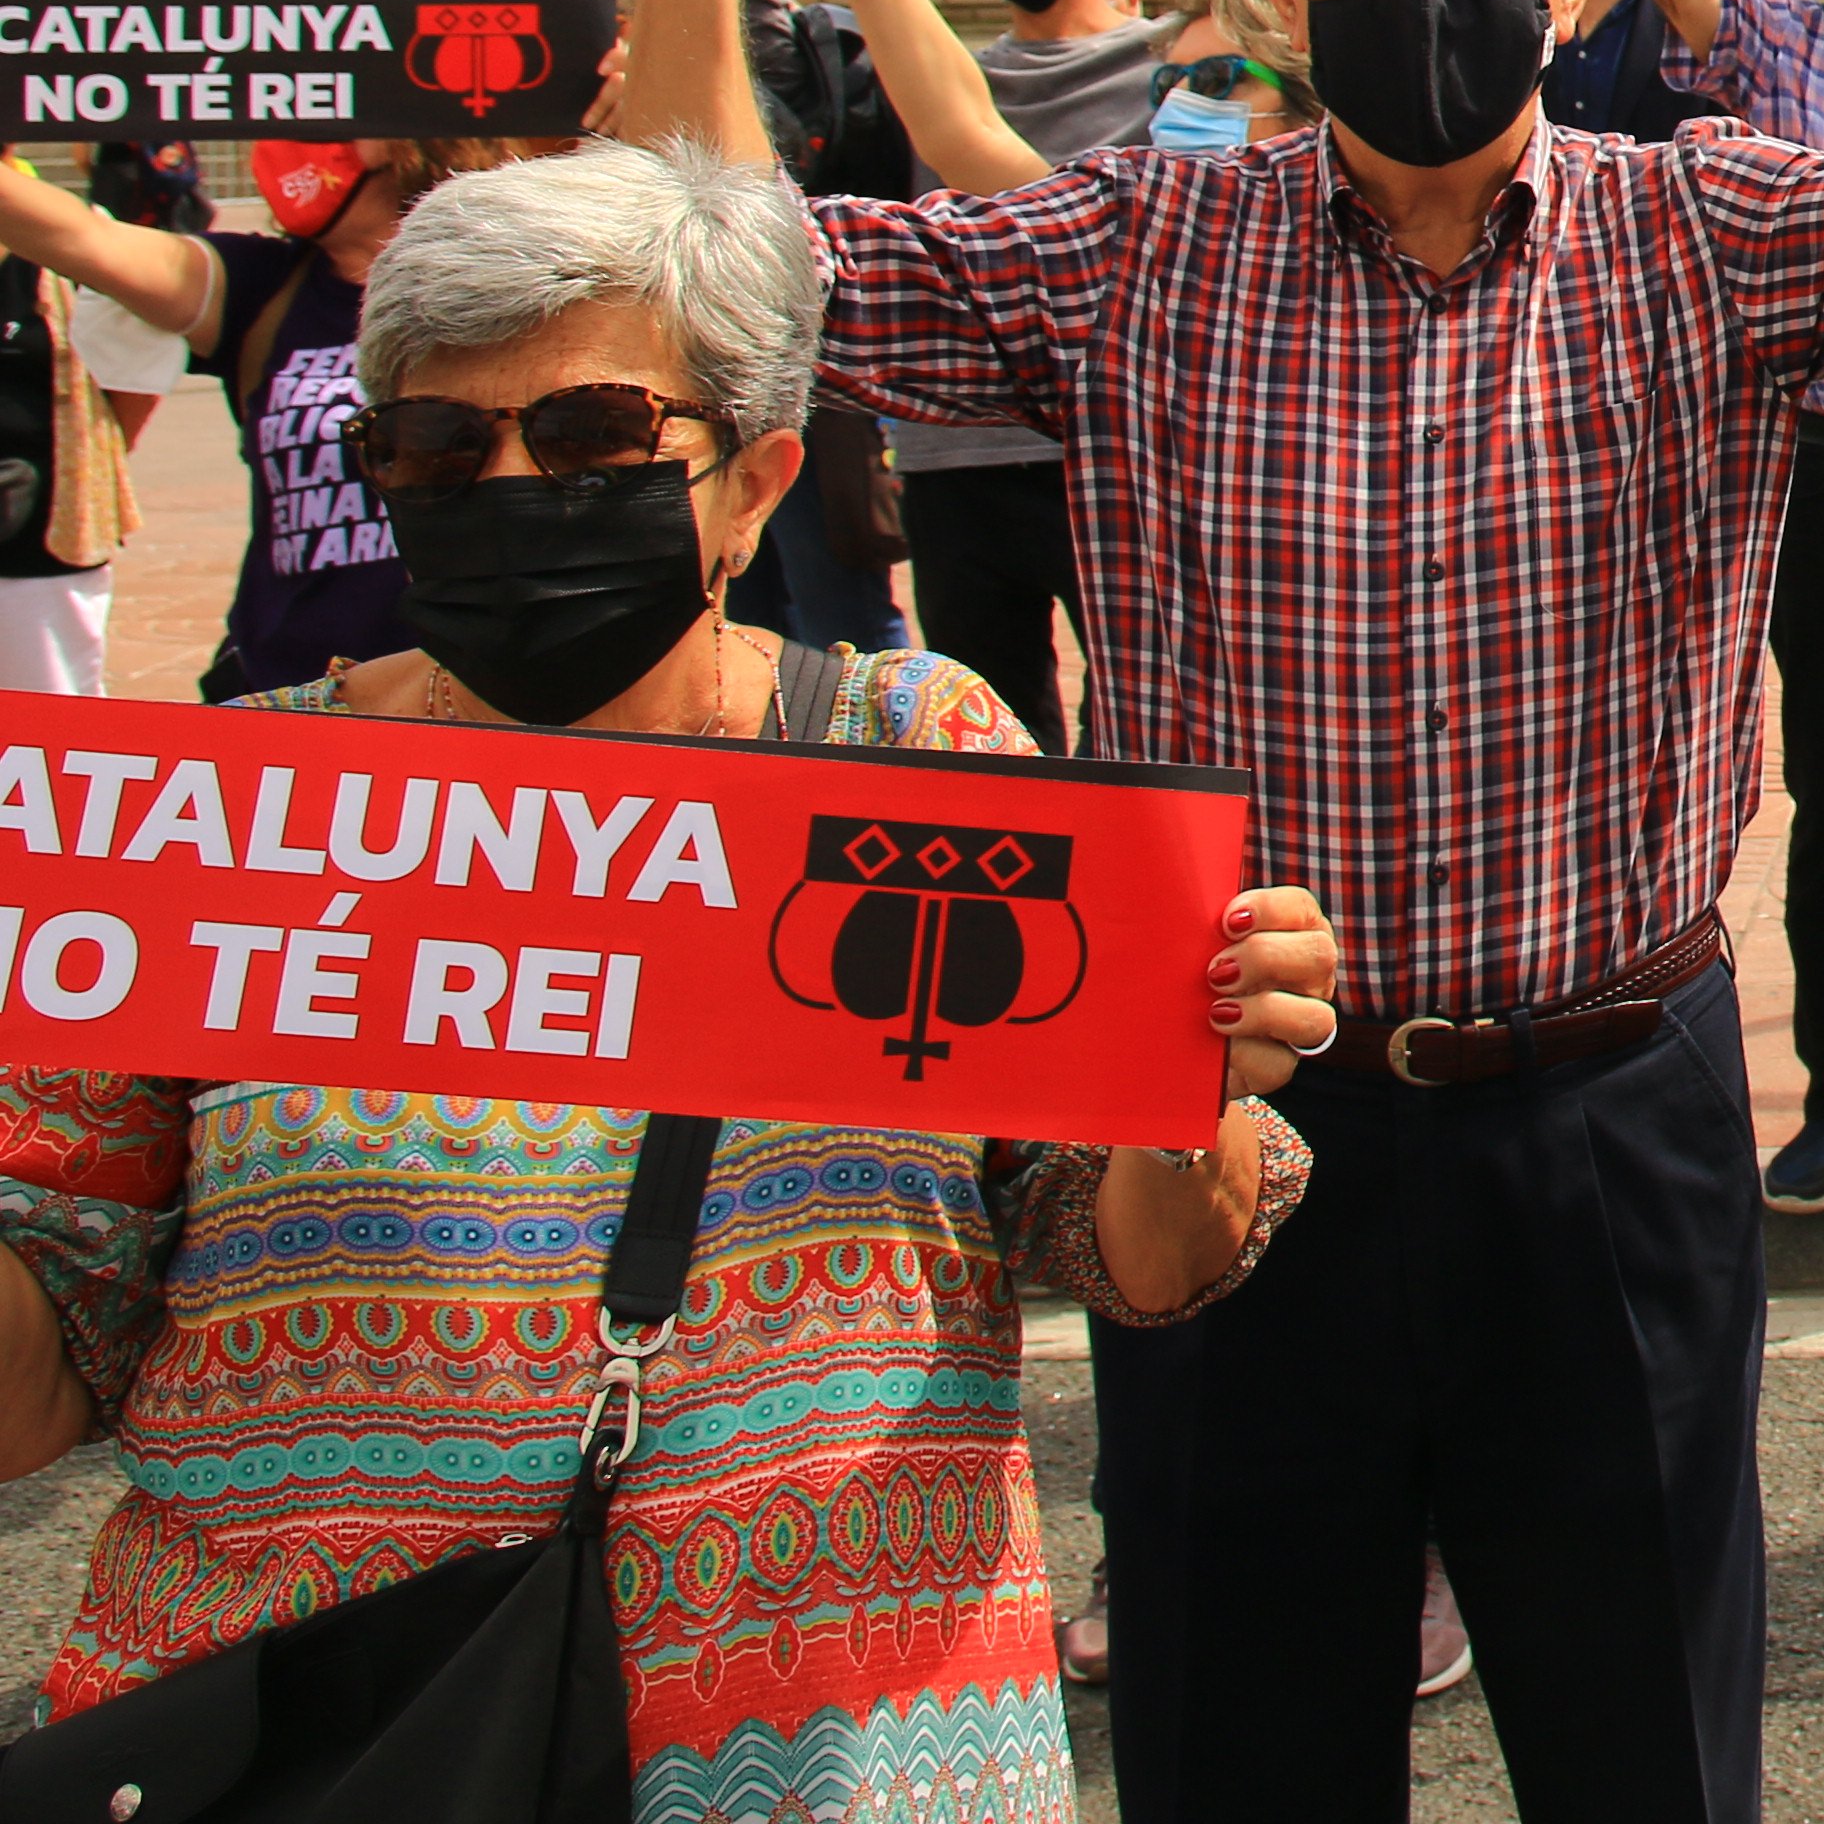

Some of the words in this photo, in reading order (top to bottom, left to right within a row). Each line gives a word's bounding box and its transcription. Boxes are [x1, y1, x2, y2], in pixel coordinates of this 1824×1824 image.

[0, 5, 392, 55] CATALUNYA
[23, 73, 129, 124] NO
[147, 56, 234, 121] TÉ
[249, 72, 355, 121] REI
[0, 745, 738, 911] ATALUNYA
[188, 895, 374, 1041] TÉ
[401, 939, 644, 1062] REI
